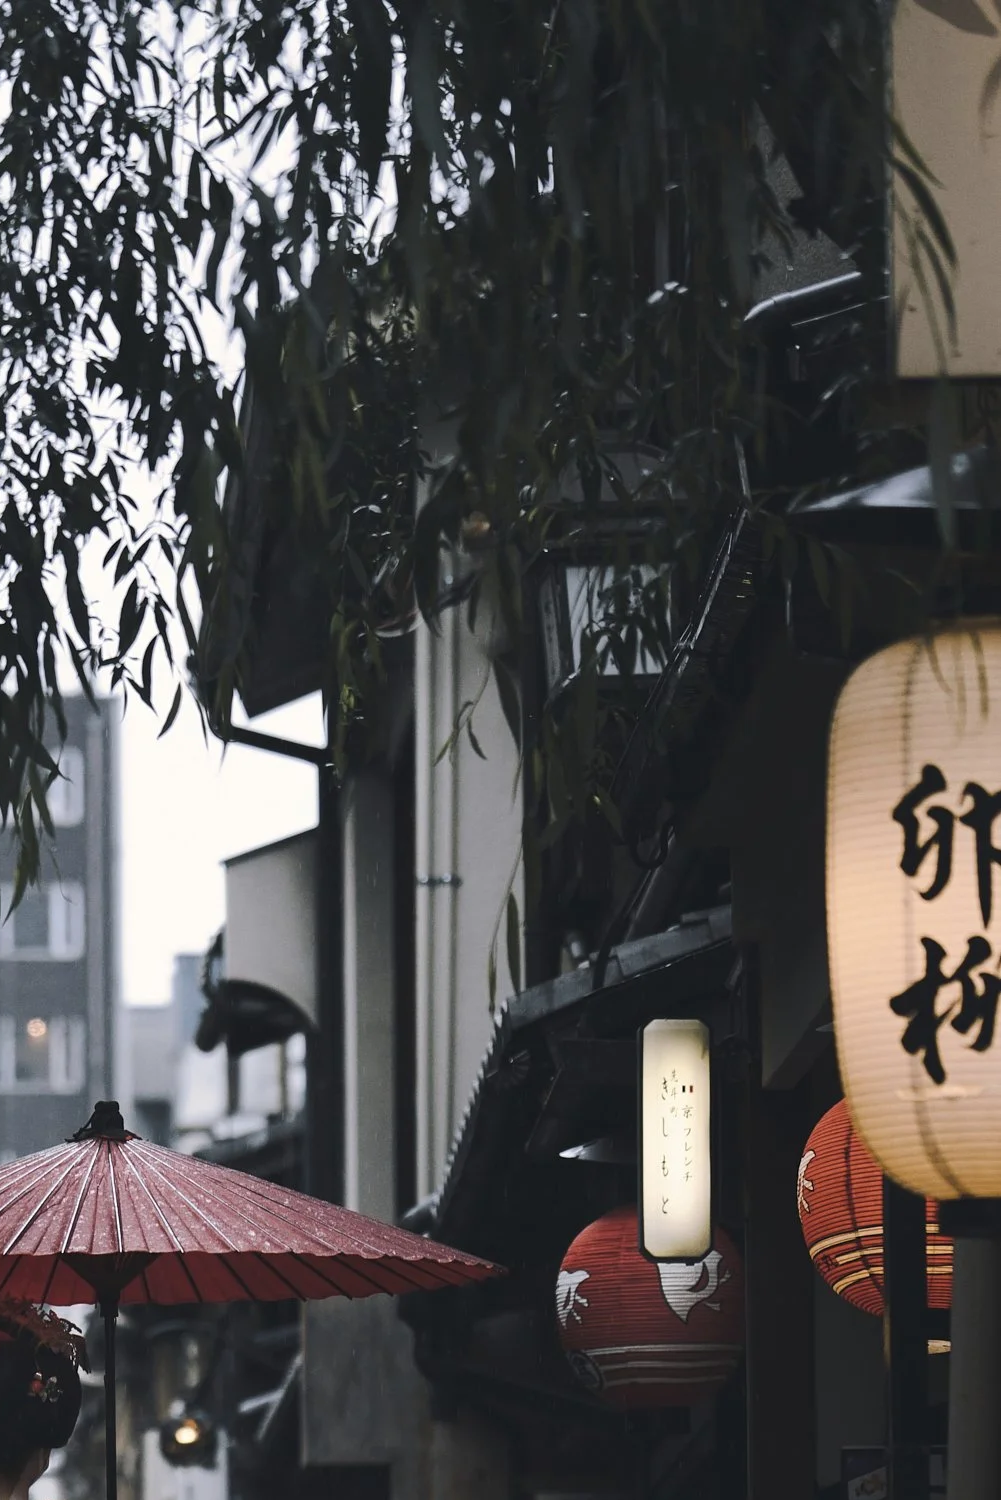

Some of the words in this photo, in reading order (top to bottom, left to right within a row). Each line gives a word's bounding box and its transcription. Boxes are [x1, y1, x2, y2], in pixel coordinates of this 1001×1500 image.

[661, 1076, 670, 1215] きしもと
[681, 1104, 694, 1183] 京フレンチ
